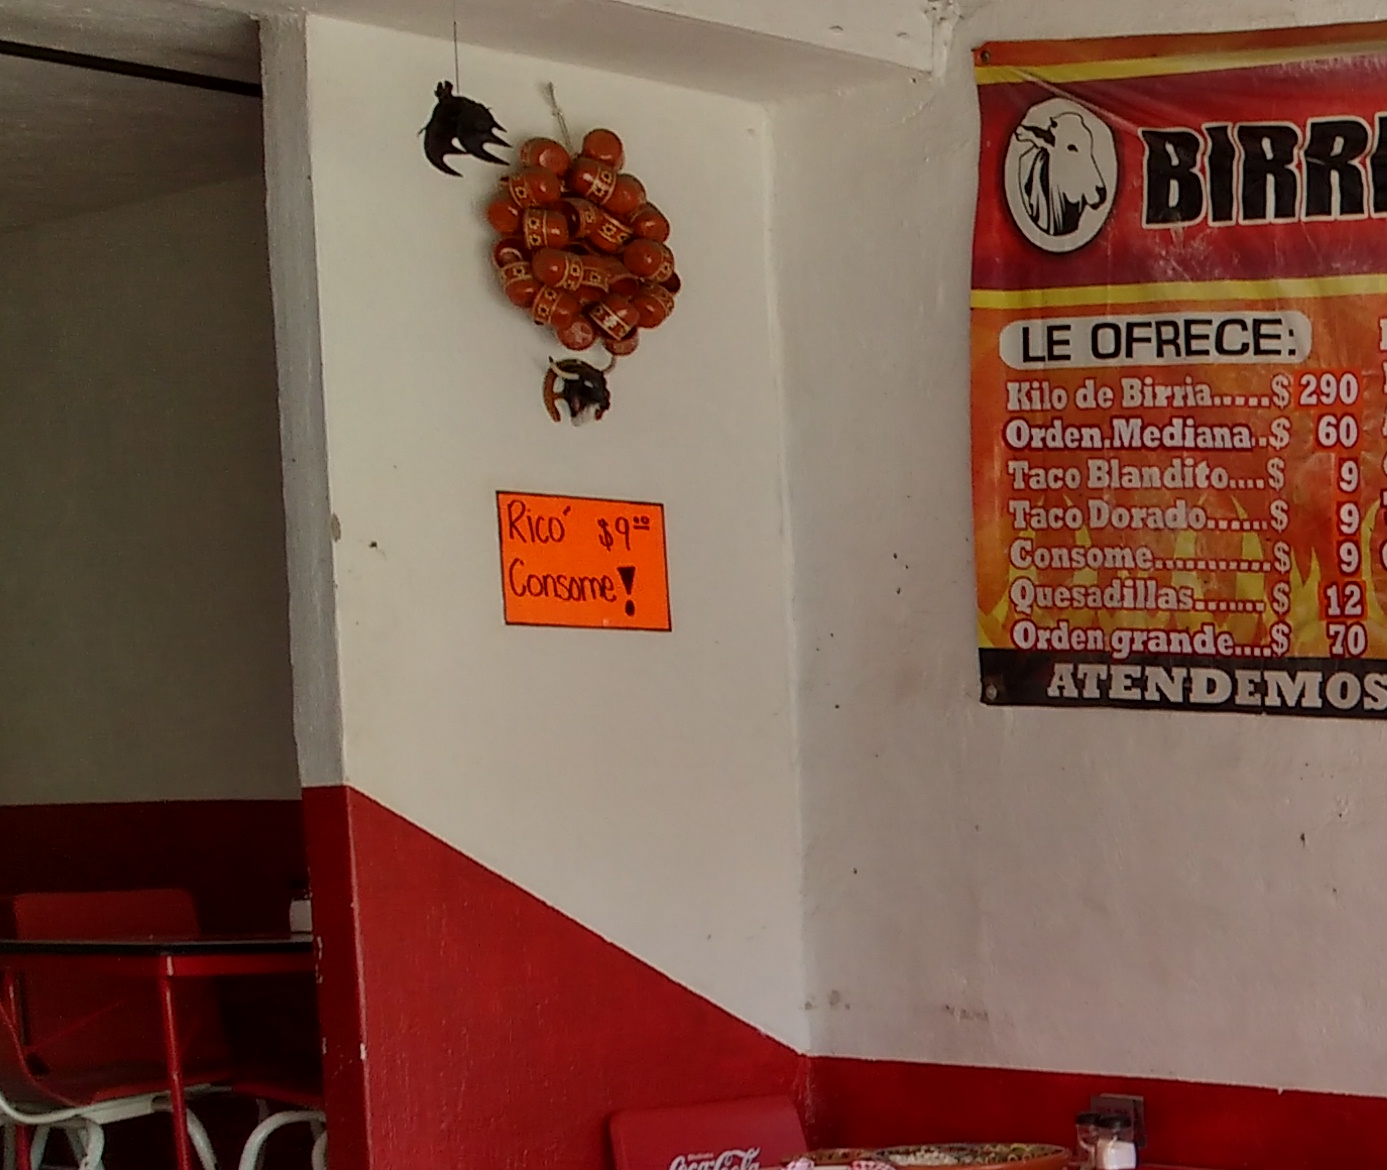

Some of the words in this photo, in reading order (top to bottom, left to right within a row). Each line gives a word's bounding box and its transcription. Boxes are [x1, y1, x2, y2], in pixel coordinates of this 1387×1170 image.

[1021, 324, 1072, 363] LE
[1090, 317, 1297, 360] OFRECE:
[1006, 380, 1067, 411] Kilo
[1075, 379, 1113, 409] de
[1300, 373, 1358, 404] 290
[1005, 419, 1102, 449] Orden
[1317, 415, 1358, 447] 60
[1008, 460, 1081, 489] Taco
[1339, 462, 1359, 492] 9
[1009, 500, 1082, 529] Taco
[1339, 503, 1360, 534] 9
[1339, 543, 1359, 573] 9
[1326, 584, 1363, 615] 12
[1012, 621, 1104, 651] Orden
[1328, 625, 1367, 655] 70
